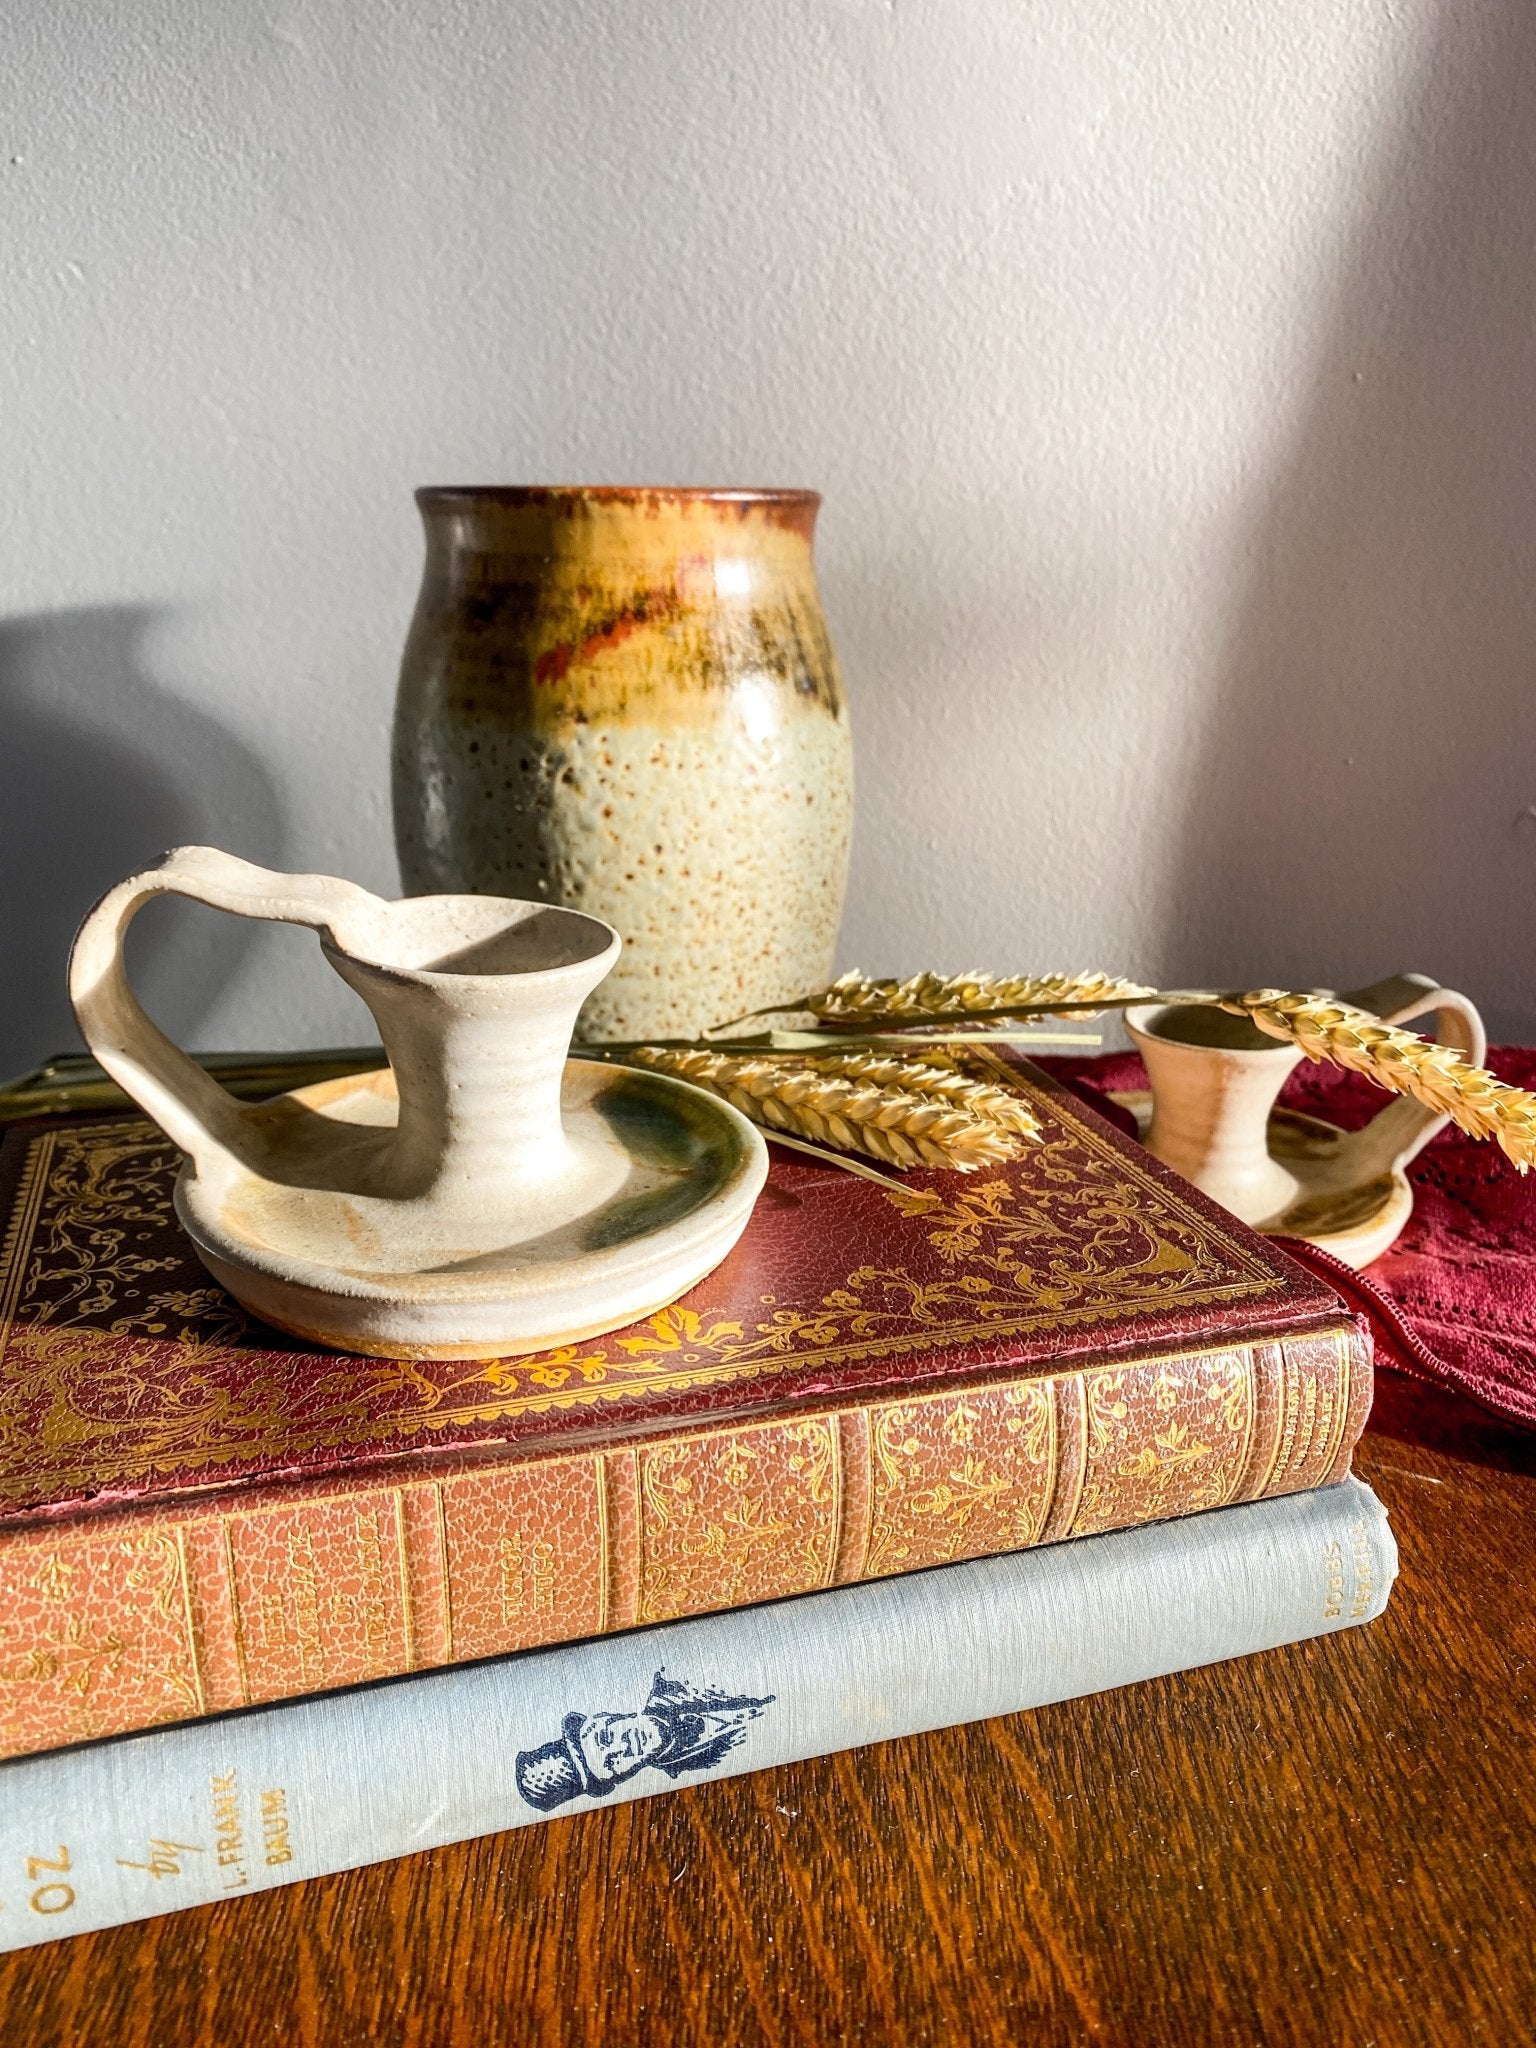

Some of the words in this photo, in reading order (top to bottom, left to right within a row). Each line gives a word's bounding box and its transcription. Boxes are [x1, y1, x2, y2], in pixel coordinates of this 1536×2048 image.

[1270, 1364, 1299, 1484] INTERNATIONAL
[1291, 1374, 1317, 1470] COLLECTORS
[1312, 1389, 1333, 1456] LIBRARY
[501, 1533, 523, 1625] VICTOR
[533, 1542, 554, 1611] HUGO
[1323, 1541, 1343, 1620] BOBBS
[1348, 1520, 1371, 1619] MERRILL
[209, 1767, 244, 1867] FRANK
[258, 1788, 292, 1867] BAUM
[24, 1845, 75, 1915] OZ
[116, 1839, 204, 1880] by
[221, 1868, 248, 1891] L.
